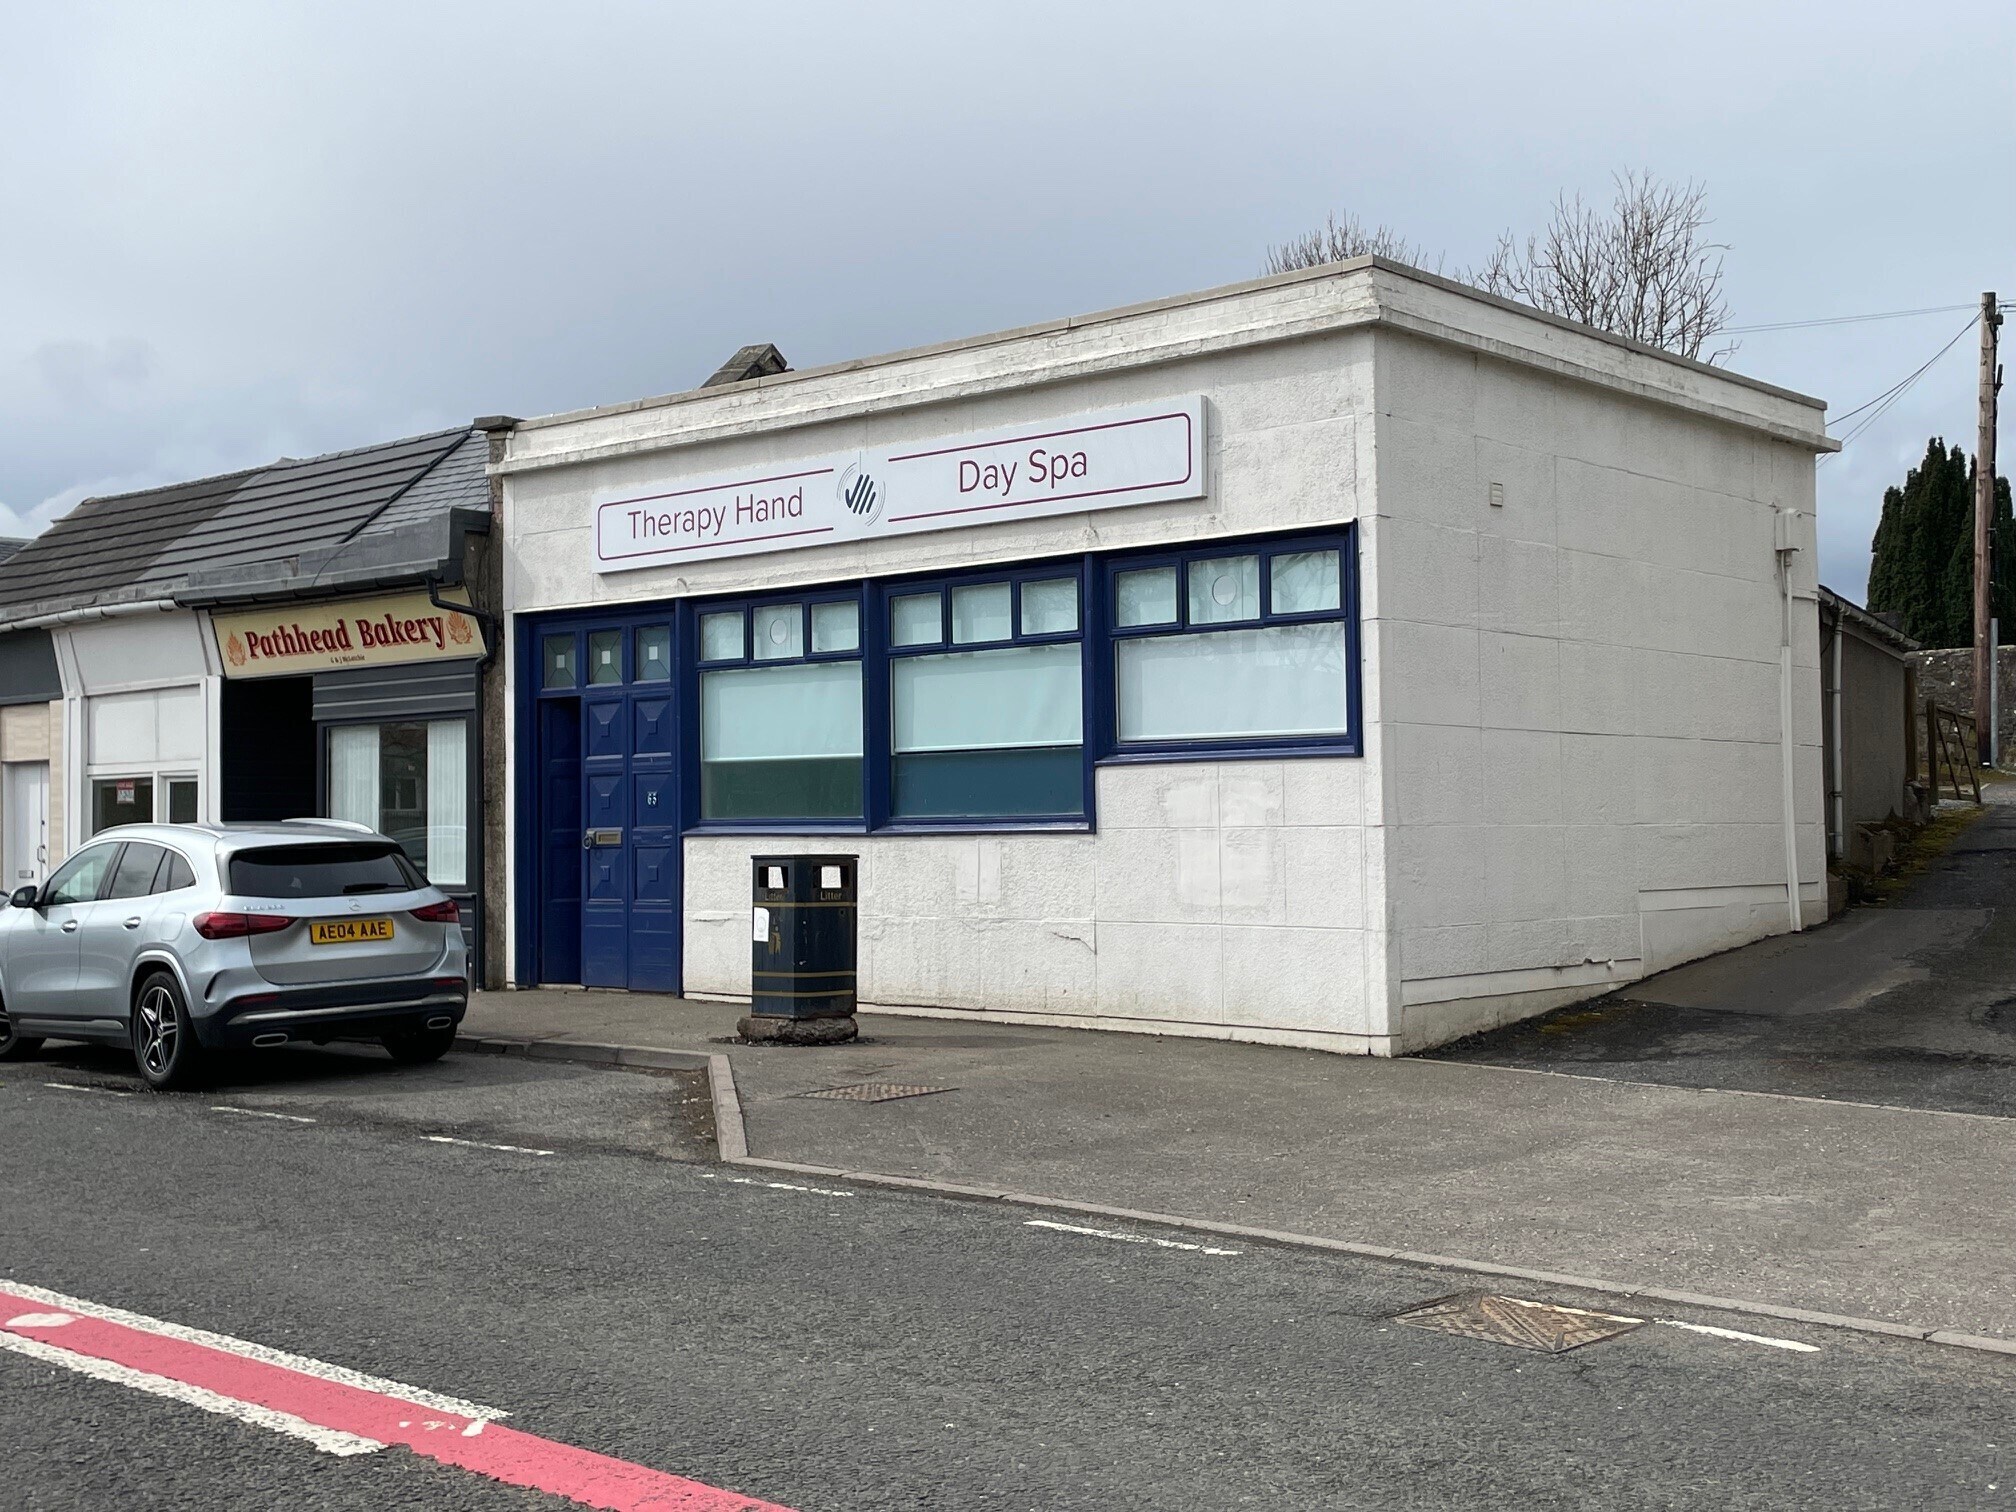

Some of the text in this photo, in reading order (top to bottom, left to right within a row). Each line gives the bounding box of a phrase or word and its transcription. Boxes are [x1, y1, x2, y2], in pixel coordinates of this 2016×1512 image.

[959, 448, 1087, 497] Day Spa
[627, 485, 803, 540] Therapy Hand
[244, 613, 445, 660] Pathhead Bakery
[647, 791, 657, 806] 65
[820, 890, 842, 901] Litter
[319, 921, 388, 940] AE04 AAE
